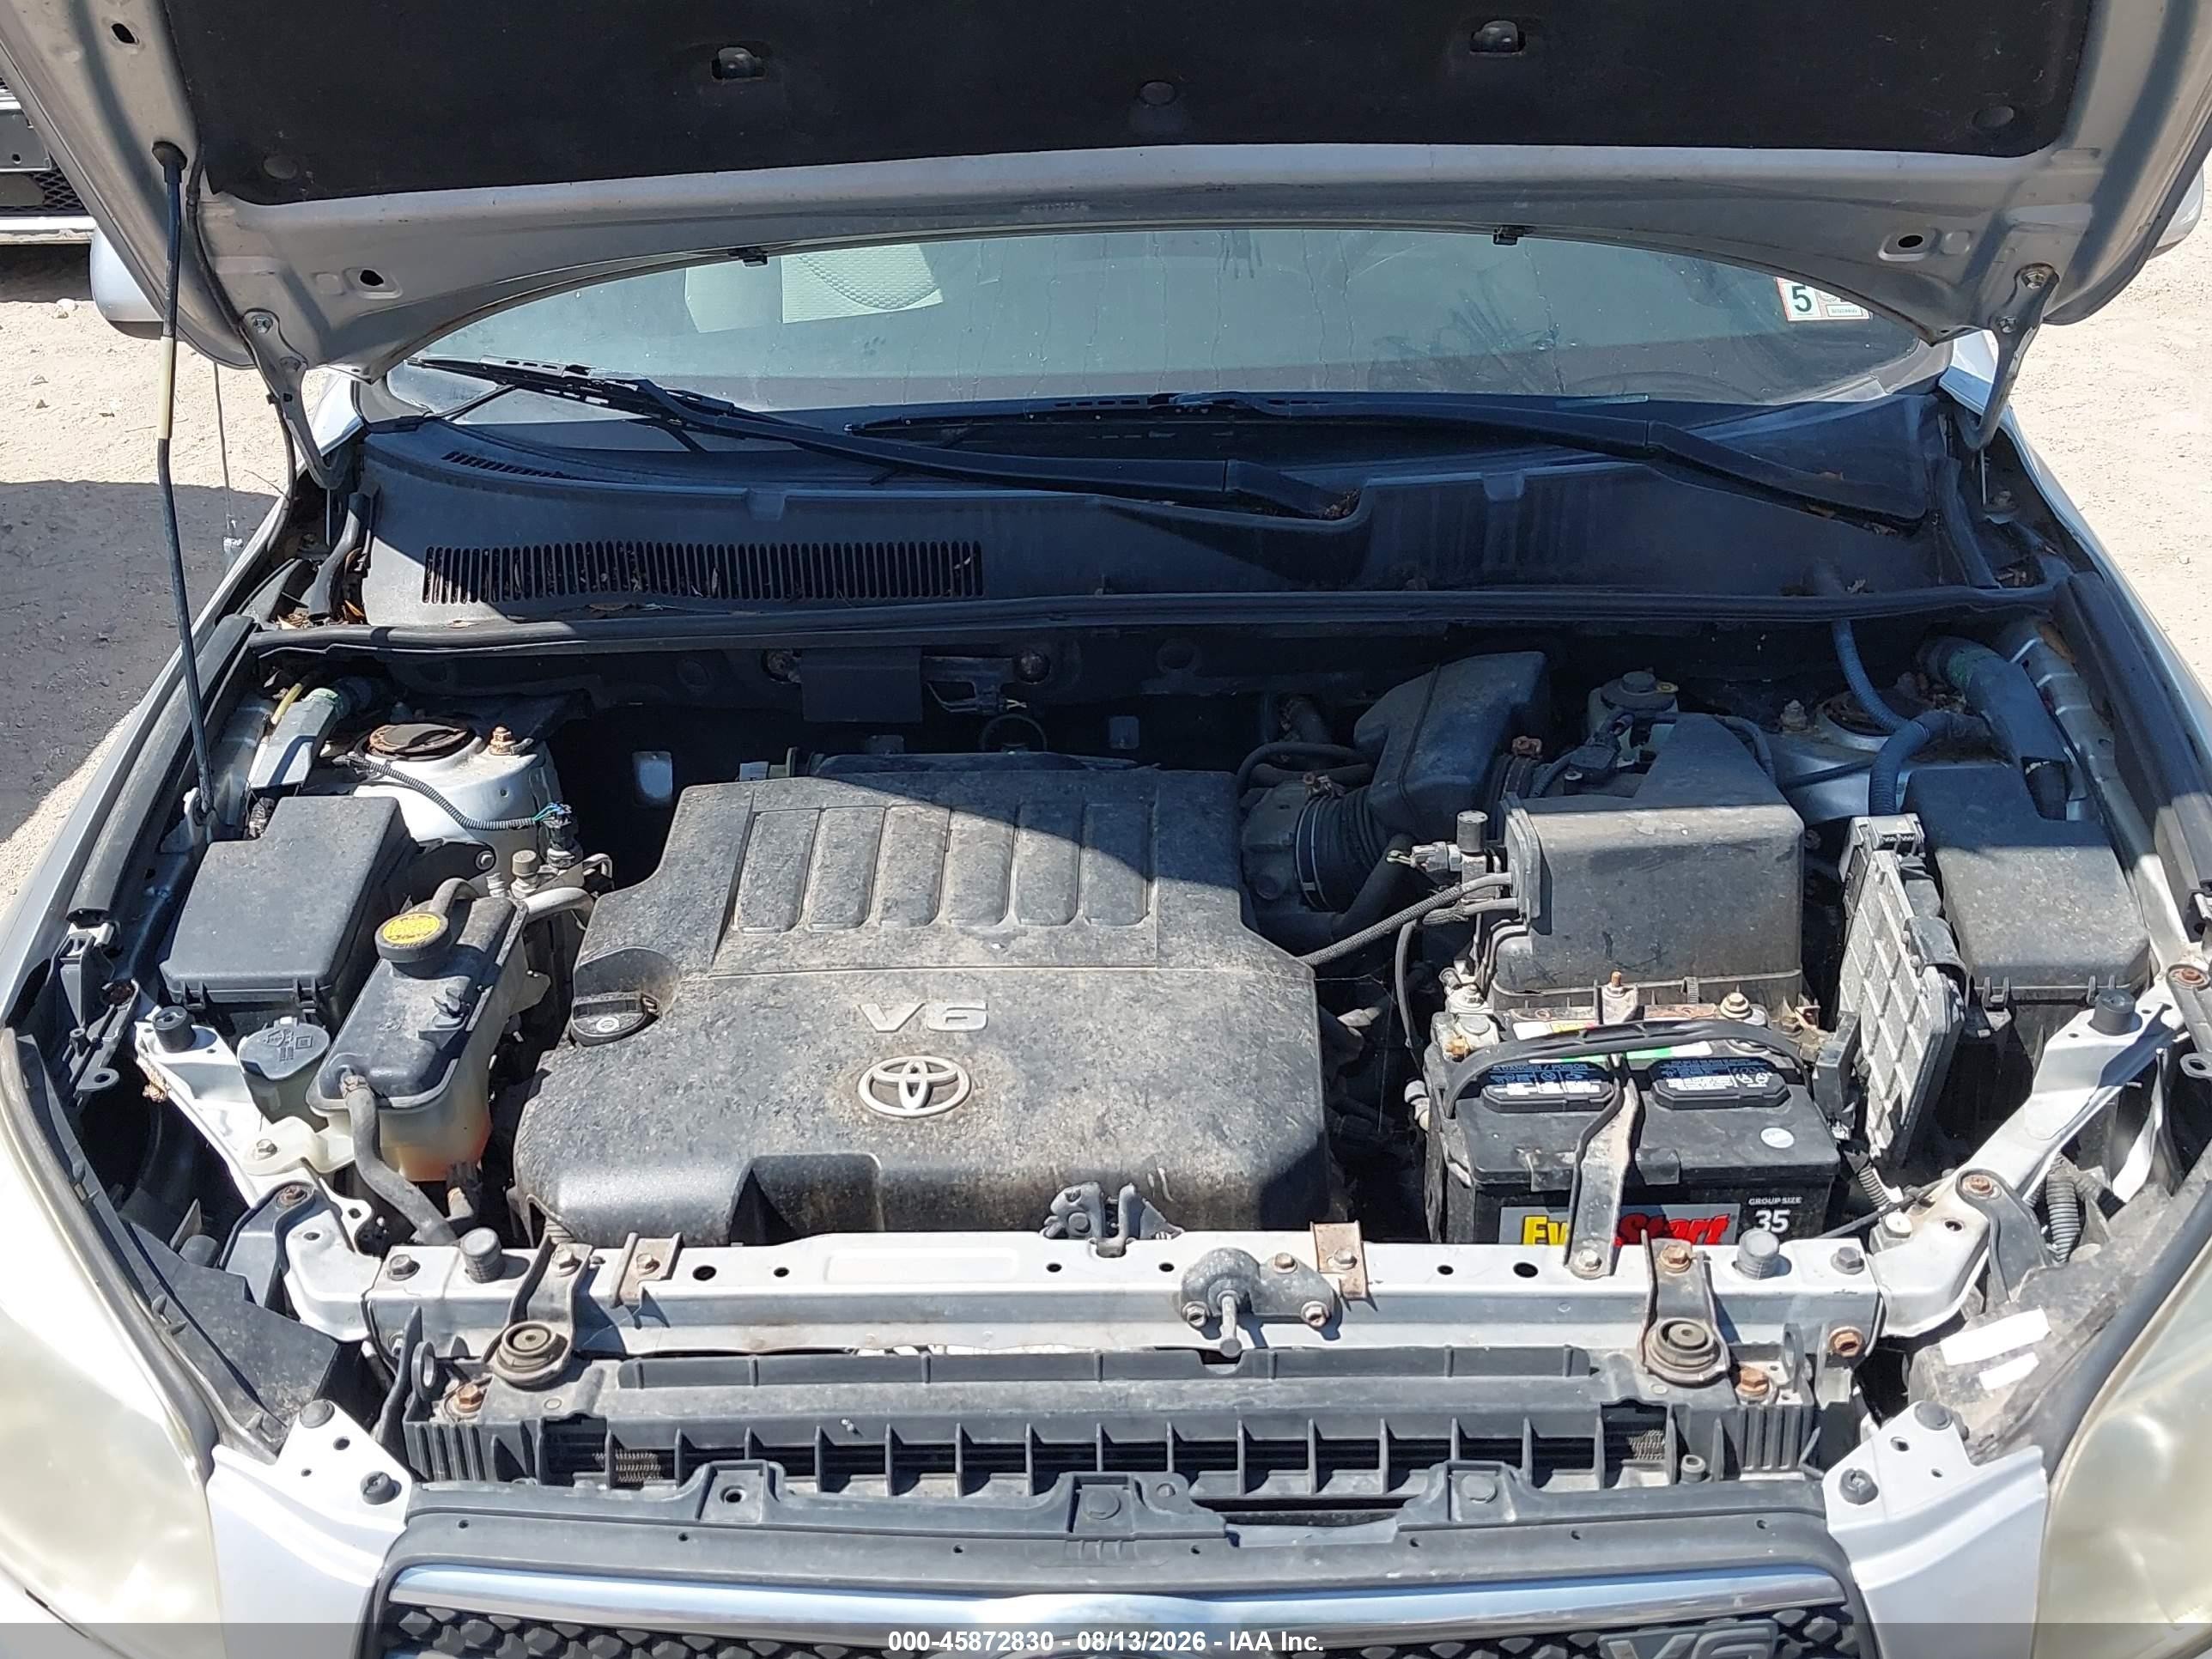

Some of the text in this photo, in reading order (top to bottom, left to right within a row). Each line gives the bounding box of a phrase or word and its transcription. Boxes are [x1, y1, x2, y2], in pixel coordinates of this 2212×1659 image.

[1791, 285, 1812, 313] 5
[858, 1001, 988, 1033] V6
[1747, 1197, 1781, 1206] GROUP
[1754, 1208, 1791, 1234] 35
